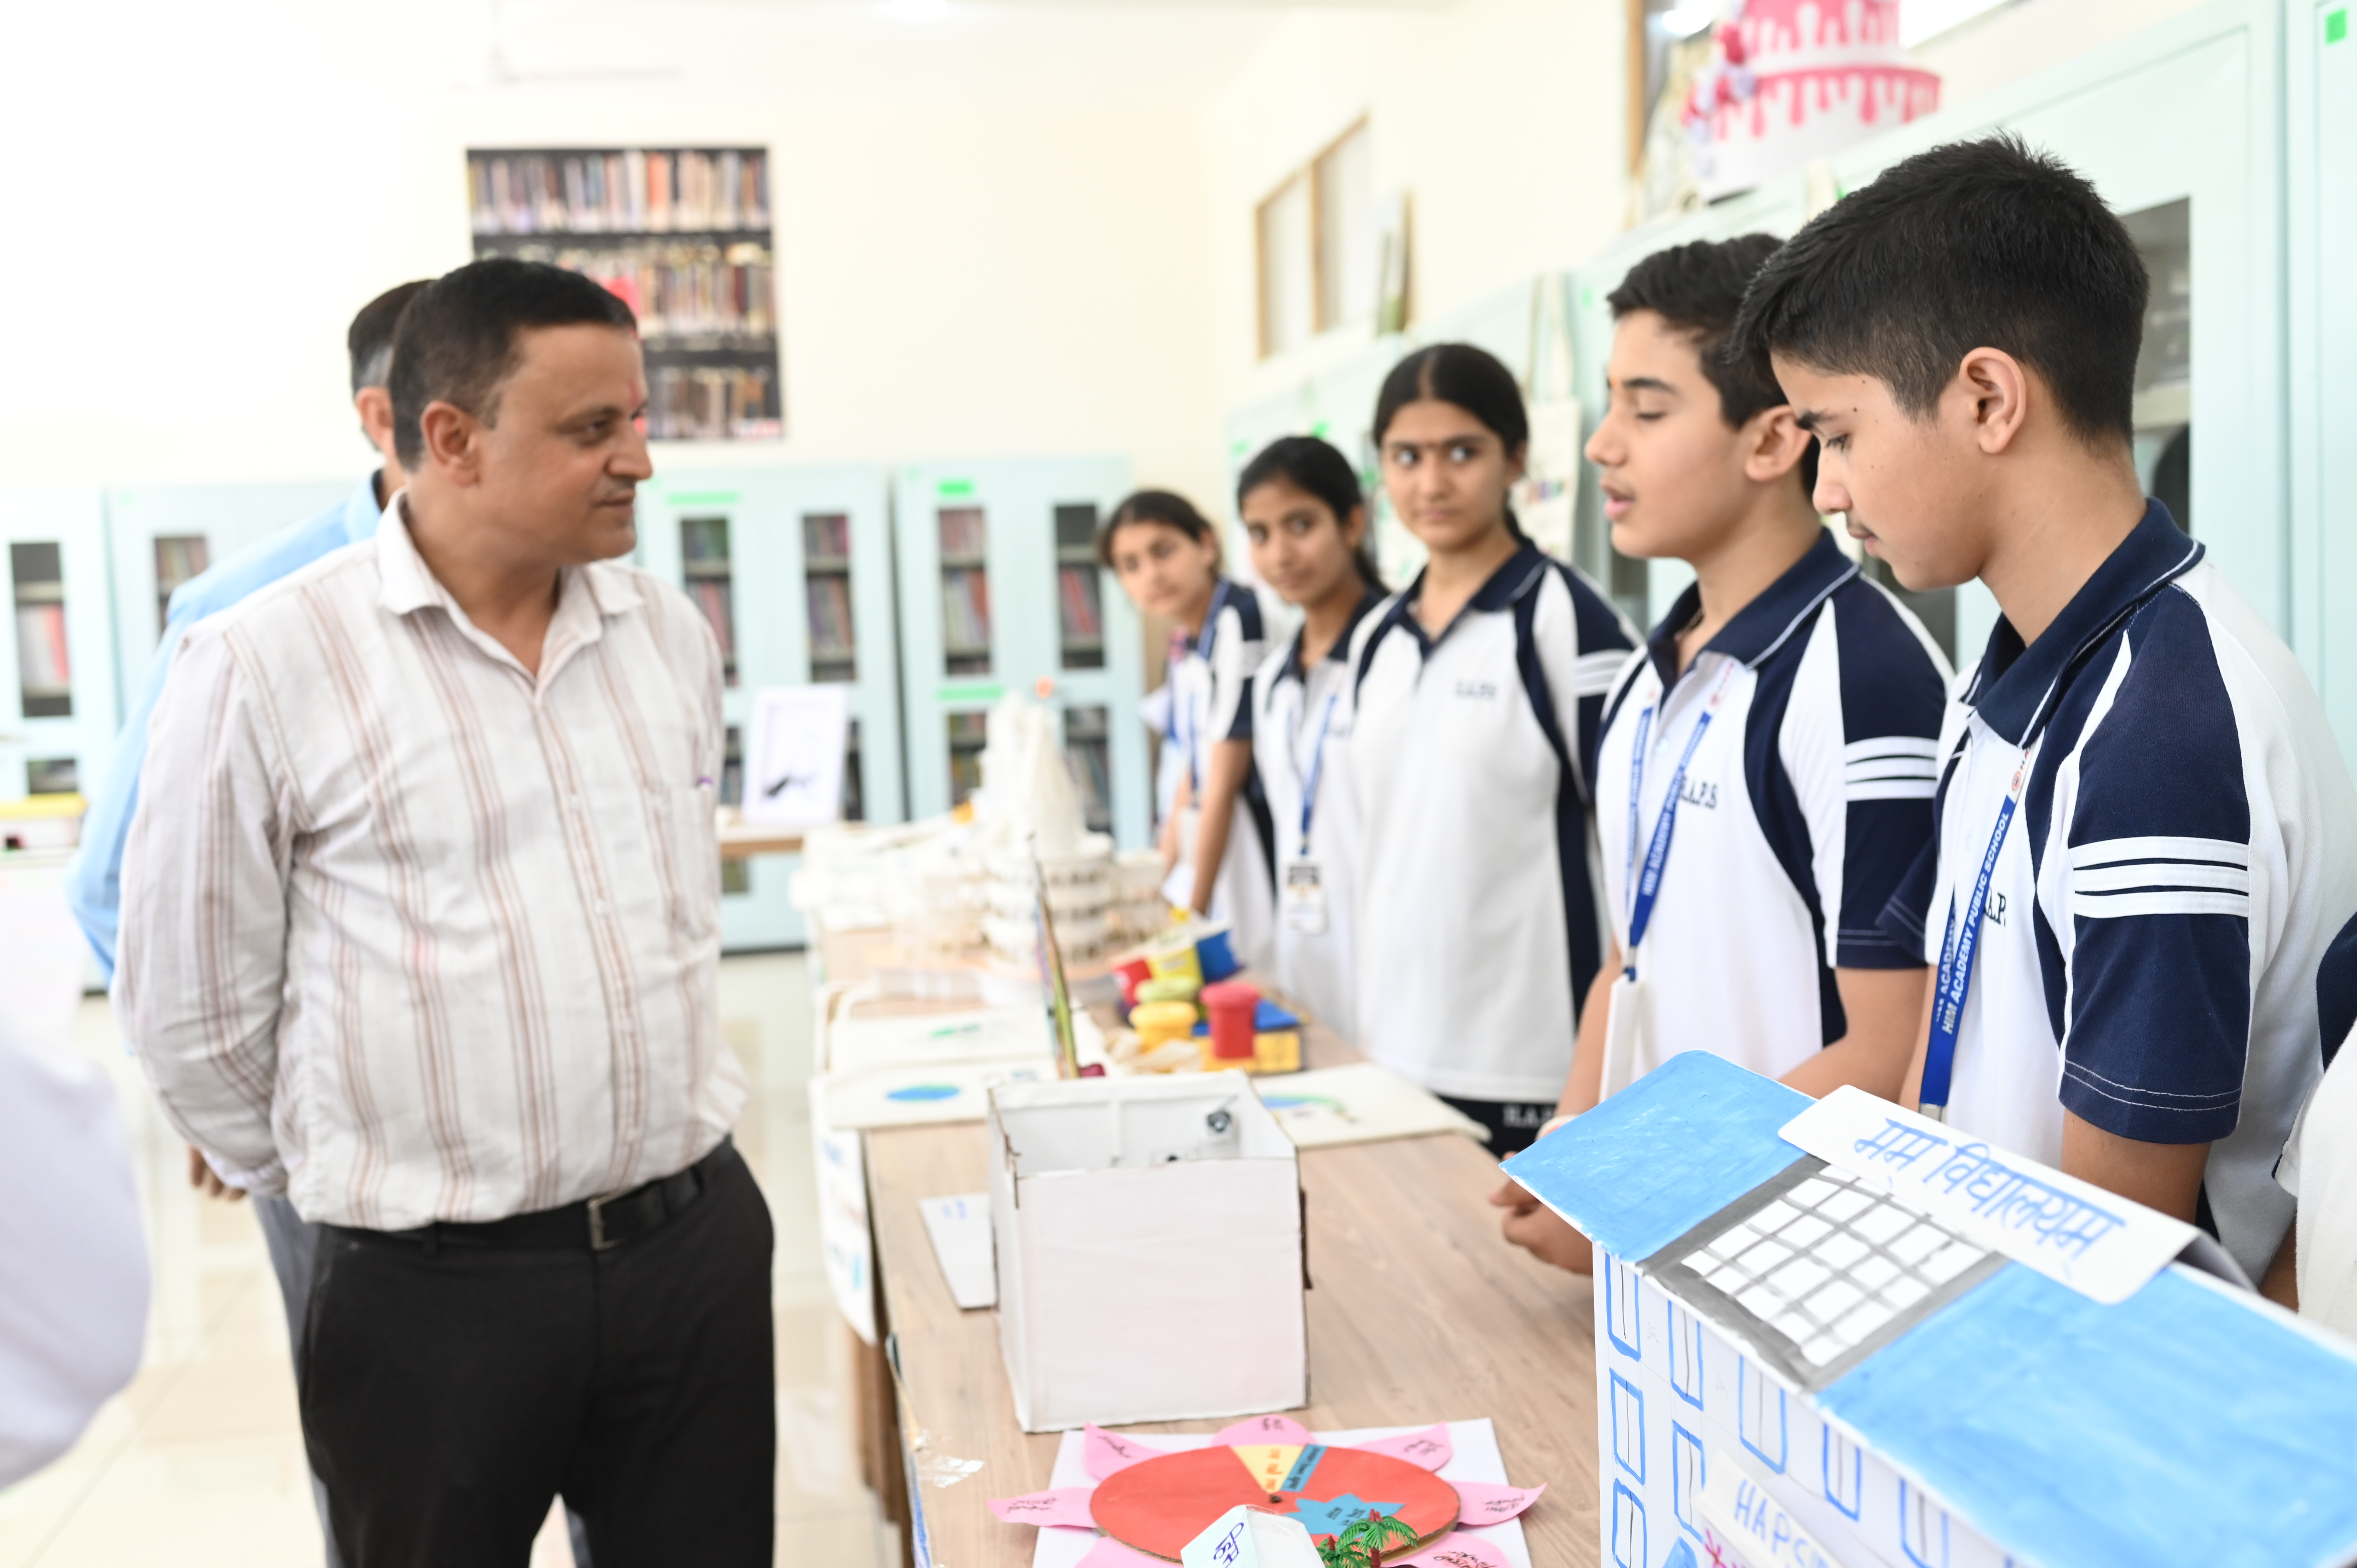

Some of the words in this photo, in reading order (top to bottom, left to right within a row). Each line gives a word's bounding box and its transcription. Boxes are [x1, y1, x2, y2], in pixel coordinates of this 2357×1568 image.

[1942, 1002, 1958, 1035] HIM
[1951, 927, 1973, 1004] ACADEMY
[1968, 873, 1987, 927] PUBLIC
[1984, 813, 2009, 873] SCHOOL
